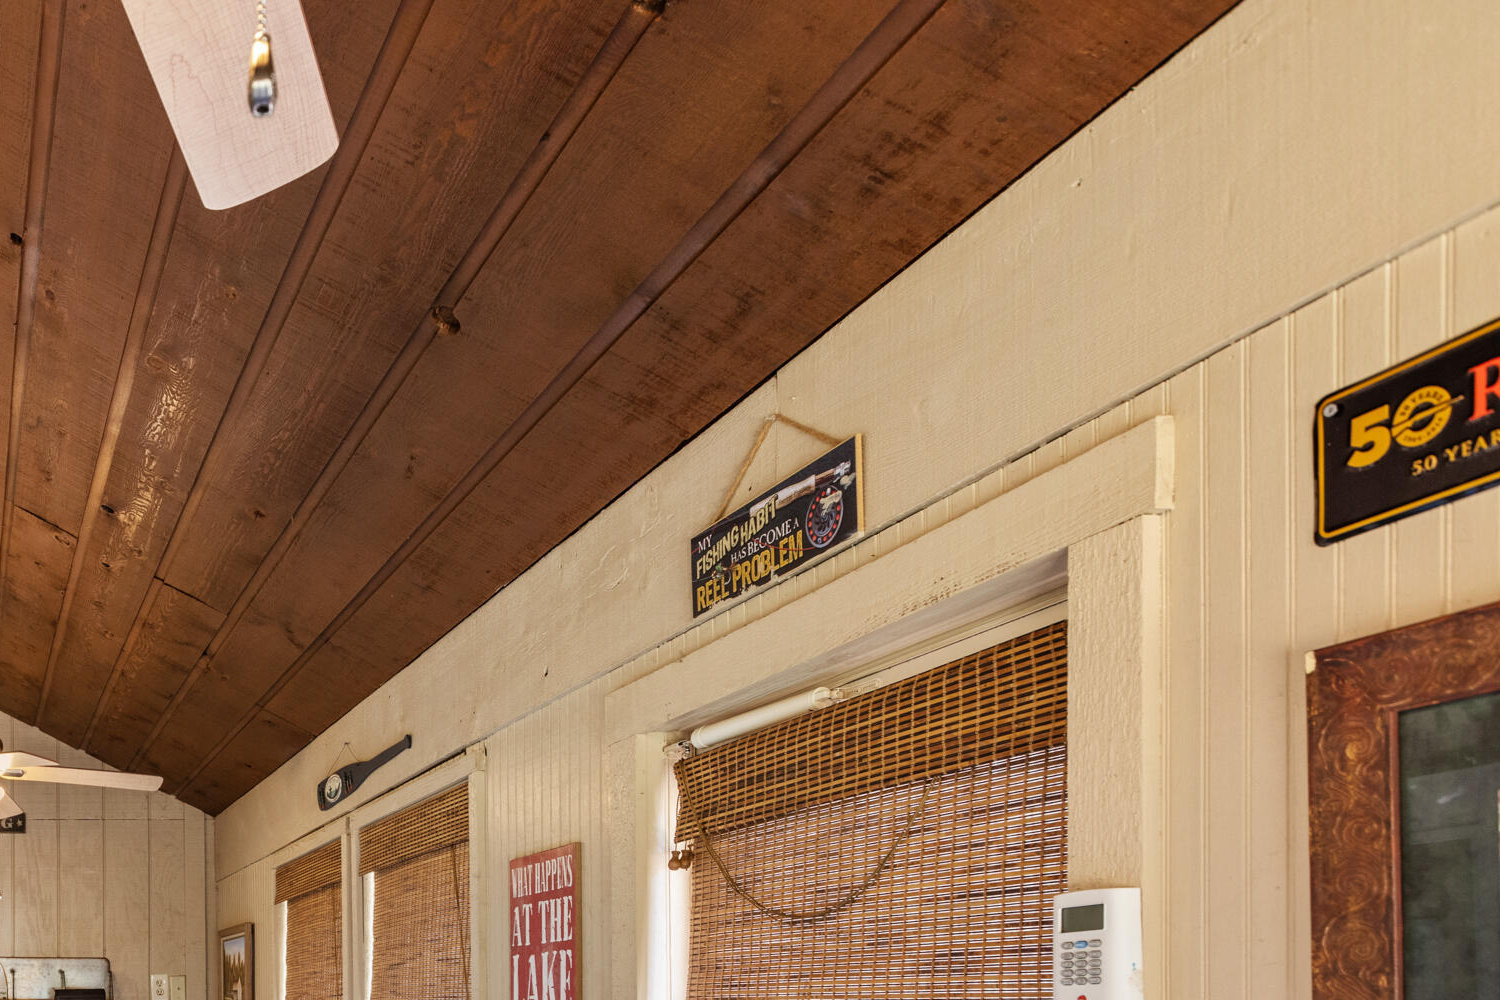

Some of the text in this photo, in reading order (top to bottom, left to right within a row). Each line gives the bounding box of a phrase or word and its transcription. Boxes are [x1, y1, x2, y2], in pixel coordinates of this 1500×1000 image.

[1347, 385, 1454, 469] 50
[1411, 453, 1438, 477] 50
[696, 494, 779, 580] FISHING HABIT
[698, 534, 712, 553] MY
[730, 517, 800, 564] HAS BECOME A
[696, 530, 804, 612] REEL PROBLEM
[511, 854, 573, 899] WHAT HAPPENS
[512, 895, 573, 947] AT THE
